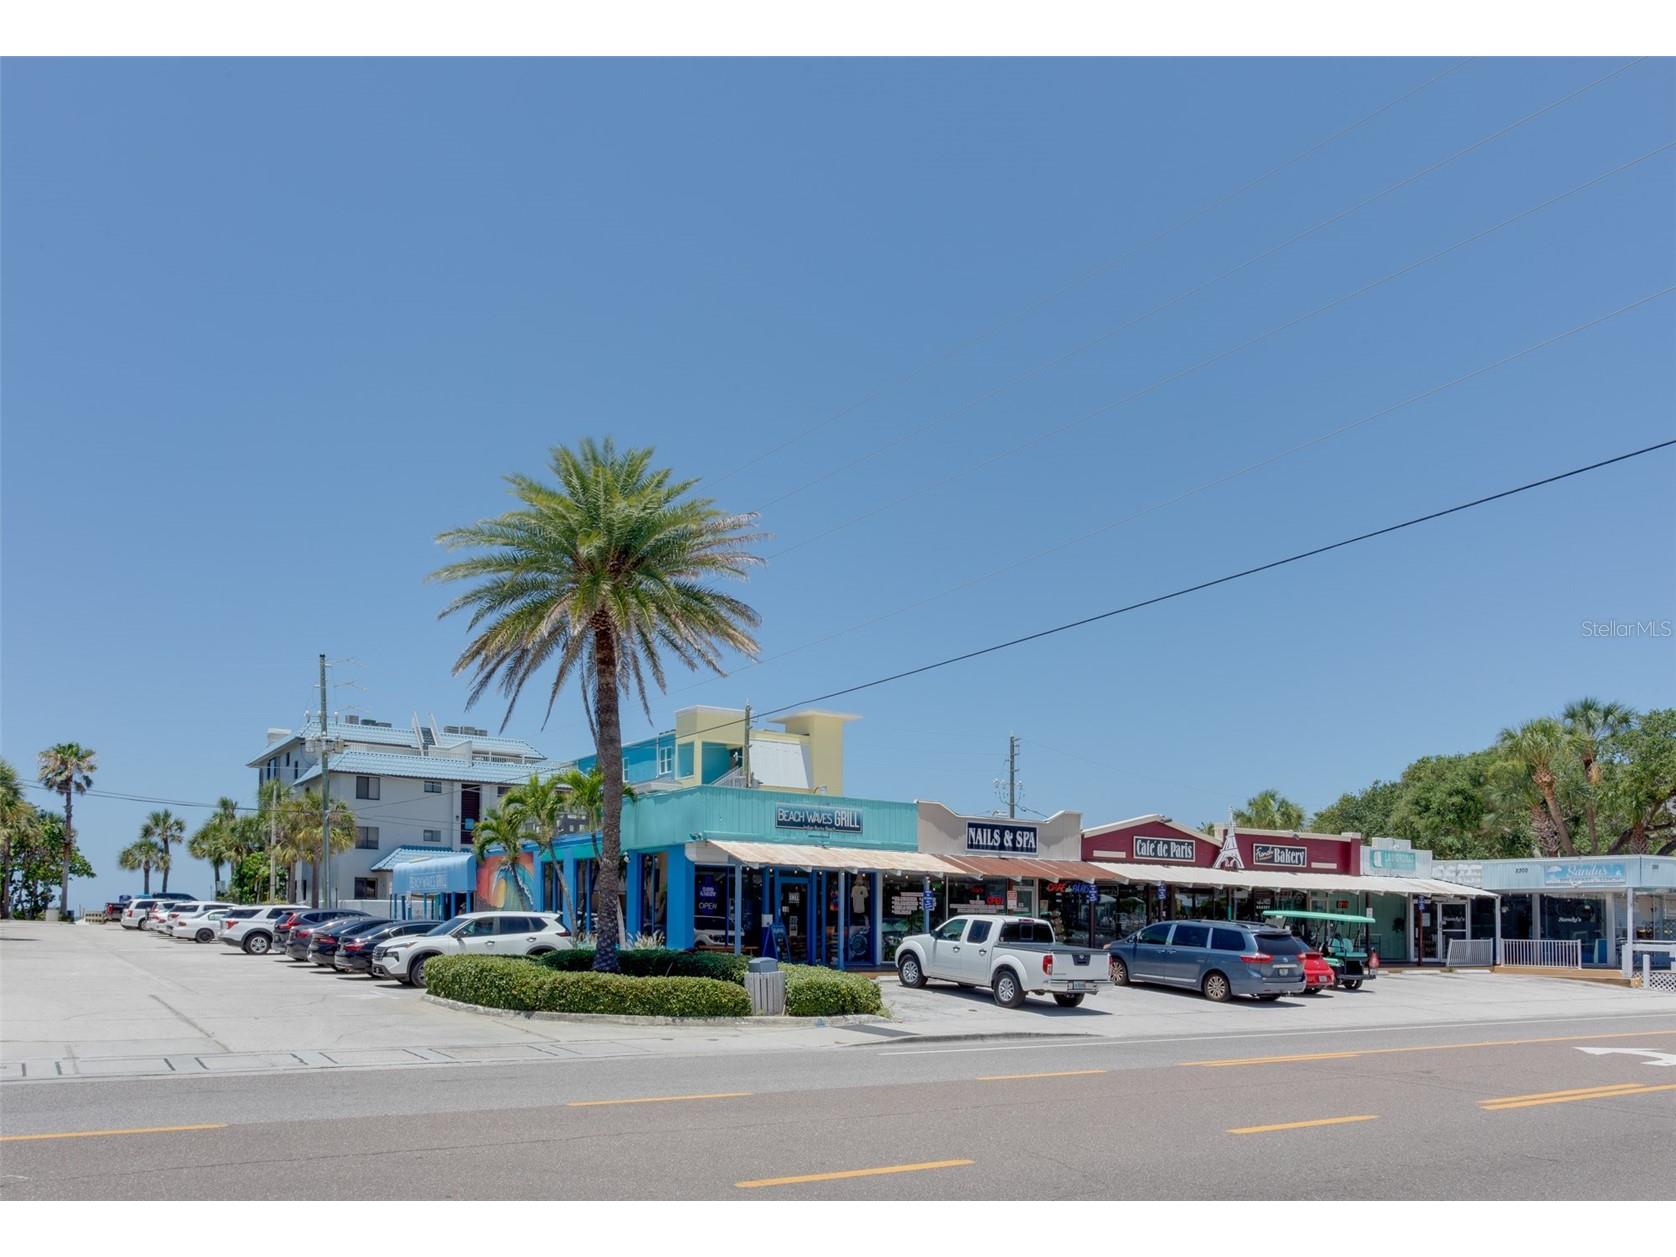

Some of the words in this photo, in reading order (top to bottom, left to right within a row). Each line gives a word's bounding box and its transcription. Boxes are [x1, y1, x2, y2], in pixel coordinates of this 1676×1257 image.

[777, 808, 805, 823] BEACH
[806, 811, 833, 825] WAVES
[834, 810, 860, 828] GRILL
[968, 827, 1001, 847] NAILS
[1003, 829, 1013, 847] &
[1016, 830, 1036, 849] SPA
[1136, 839, 1157, 857] Café
[1157, 840, 1168, 857] de
[1170, 842, 1193, 859] Paris
[1274, 848, 1305, 866] Bakery
